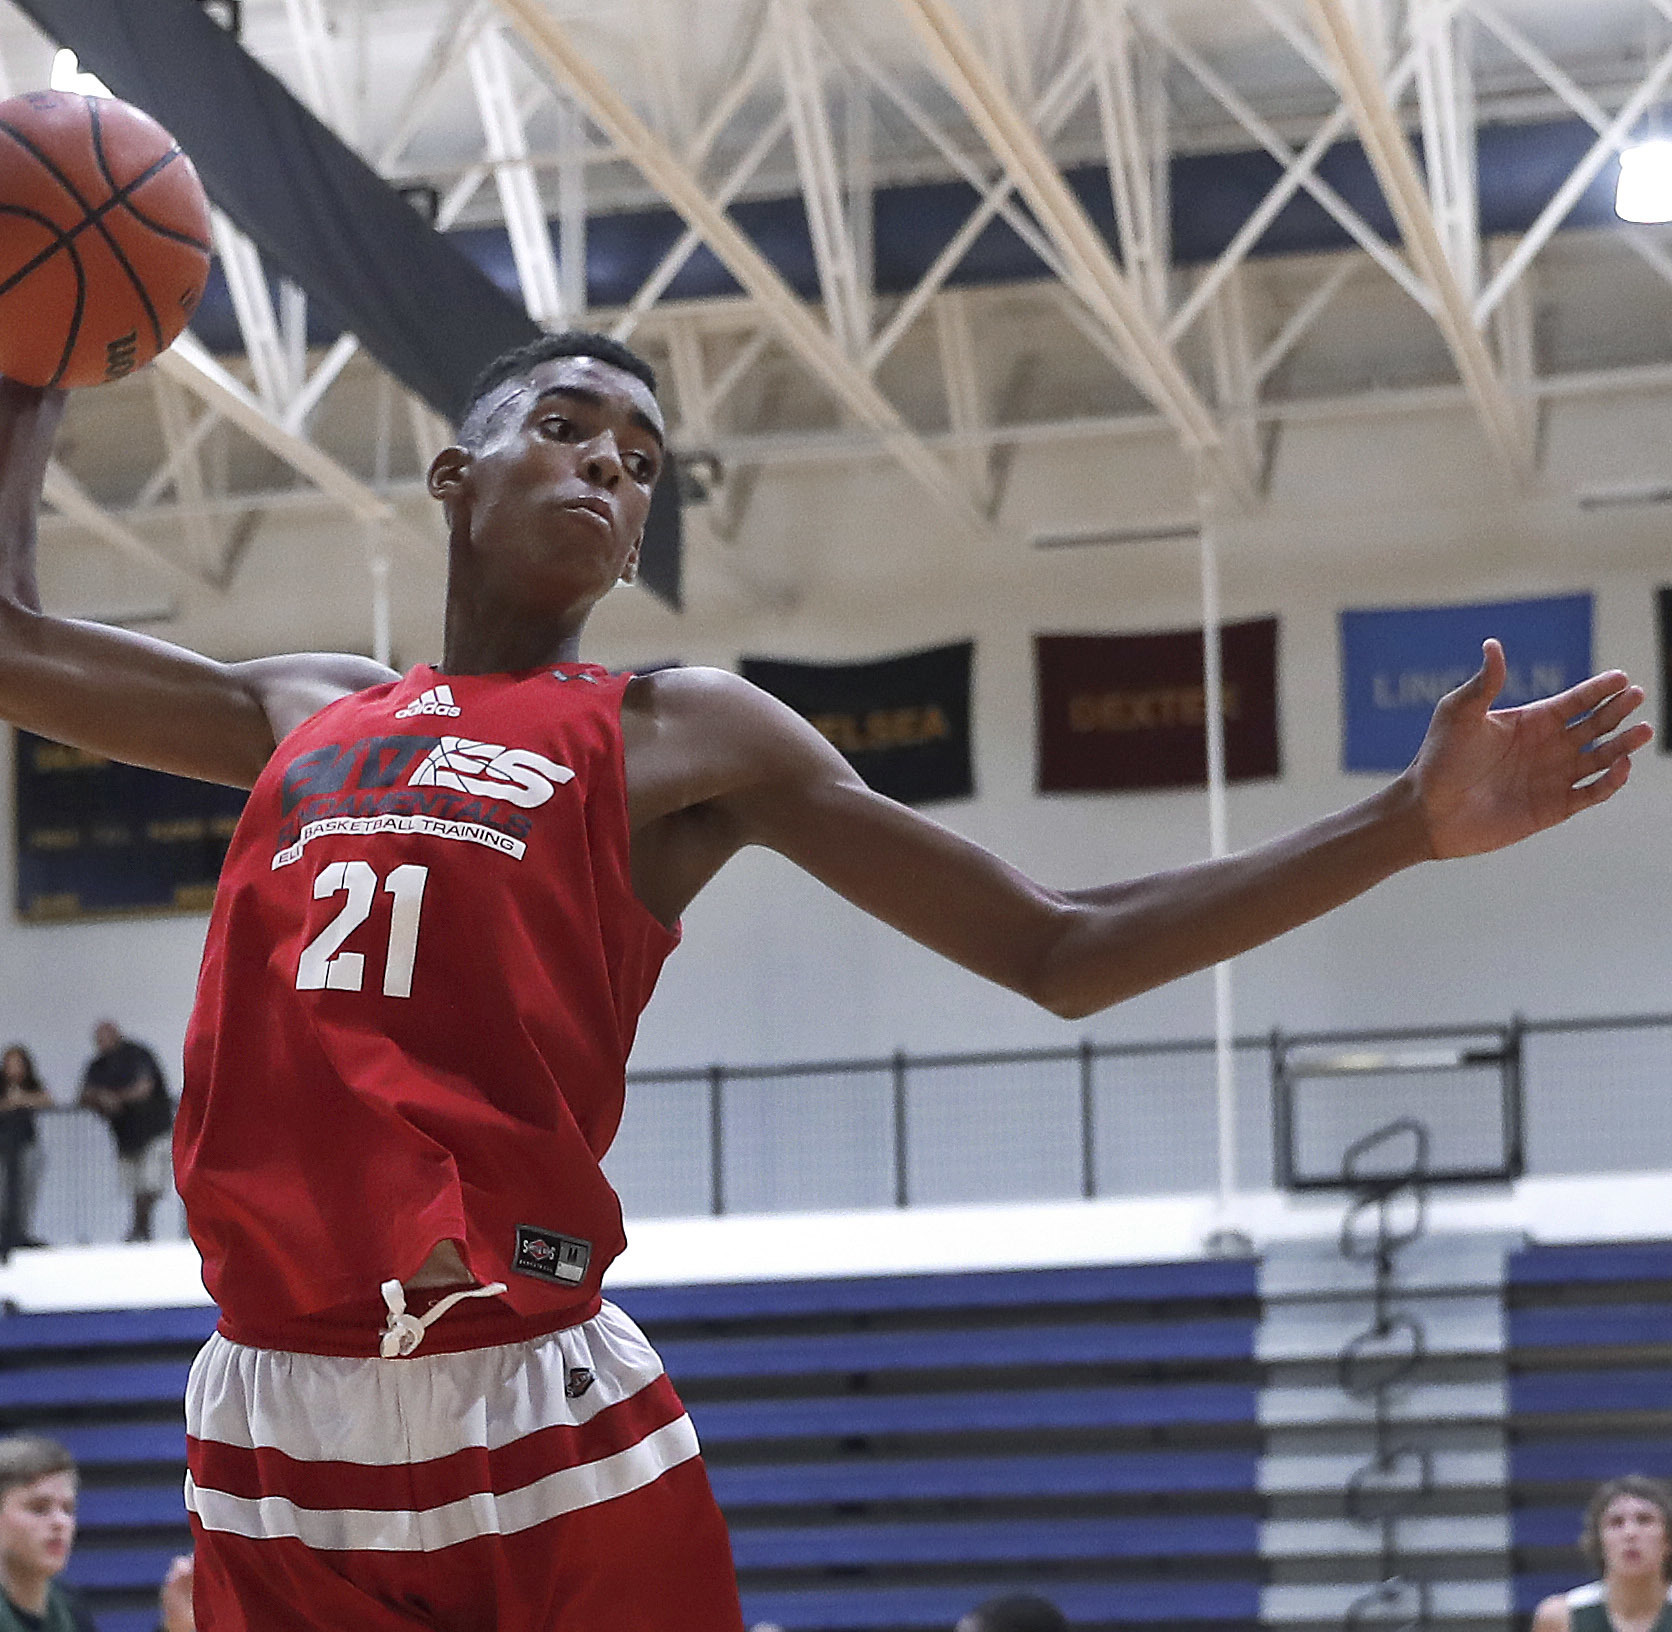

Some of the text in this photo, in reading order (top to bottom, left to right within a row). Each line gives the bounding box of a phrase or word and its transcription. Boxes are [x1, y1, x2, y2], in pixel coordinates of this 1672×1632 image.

[395, 702, 461, 719] adidas
[304, 818, 415, 840] BASKETBALL
[422, 819, 514, 851] TRAINING
[295, 861, 429, 998] 21
